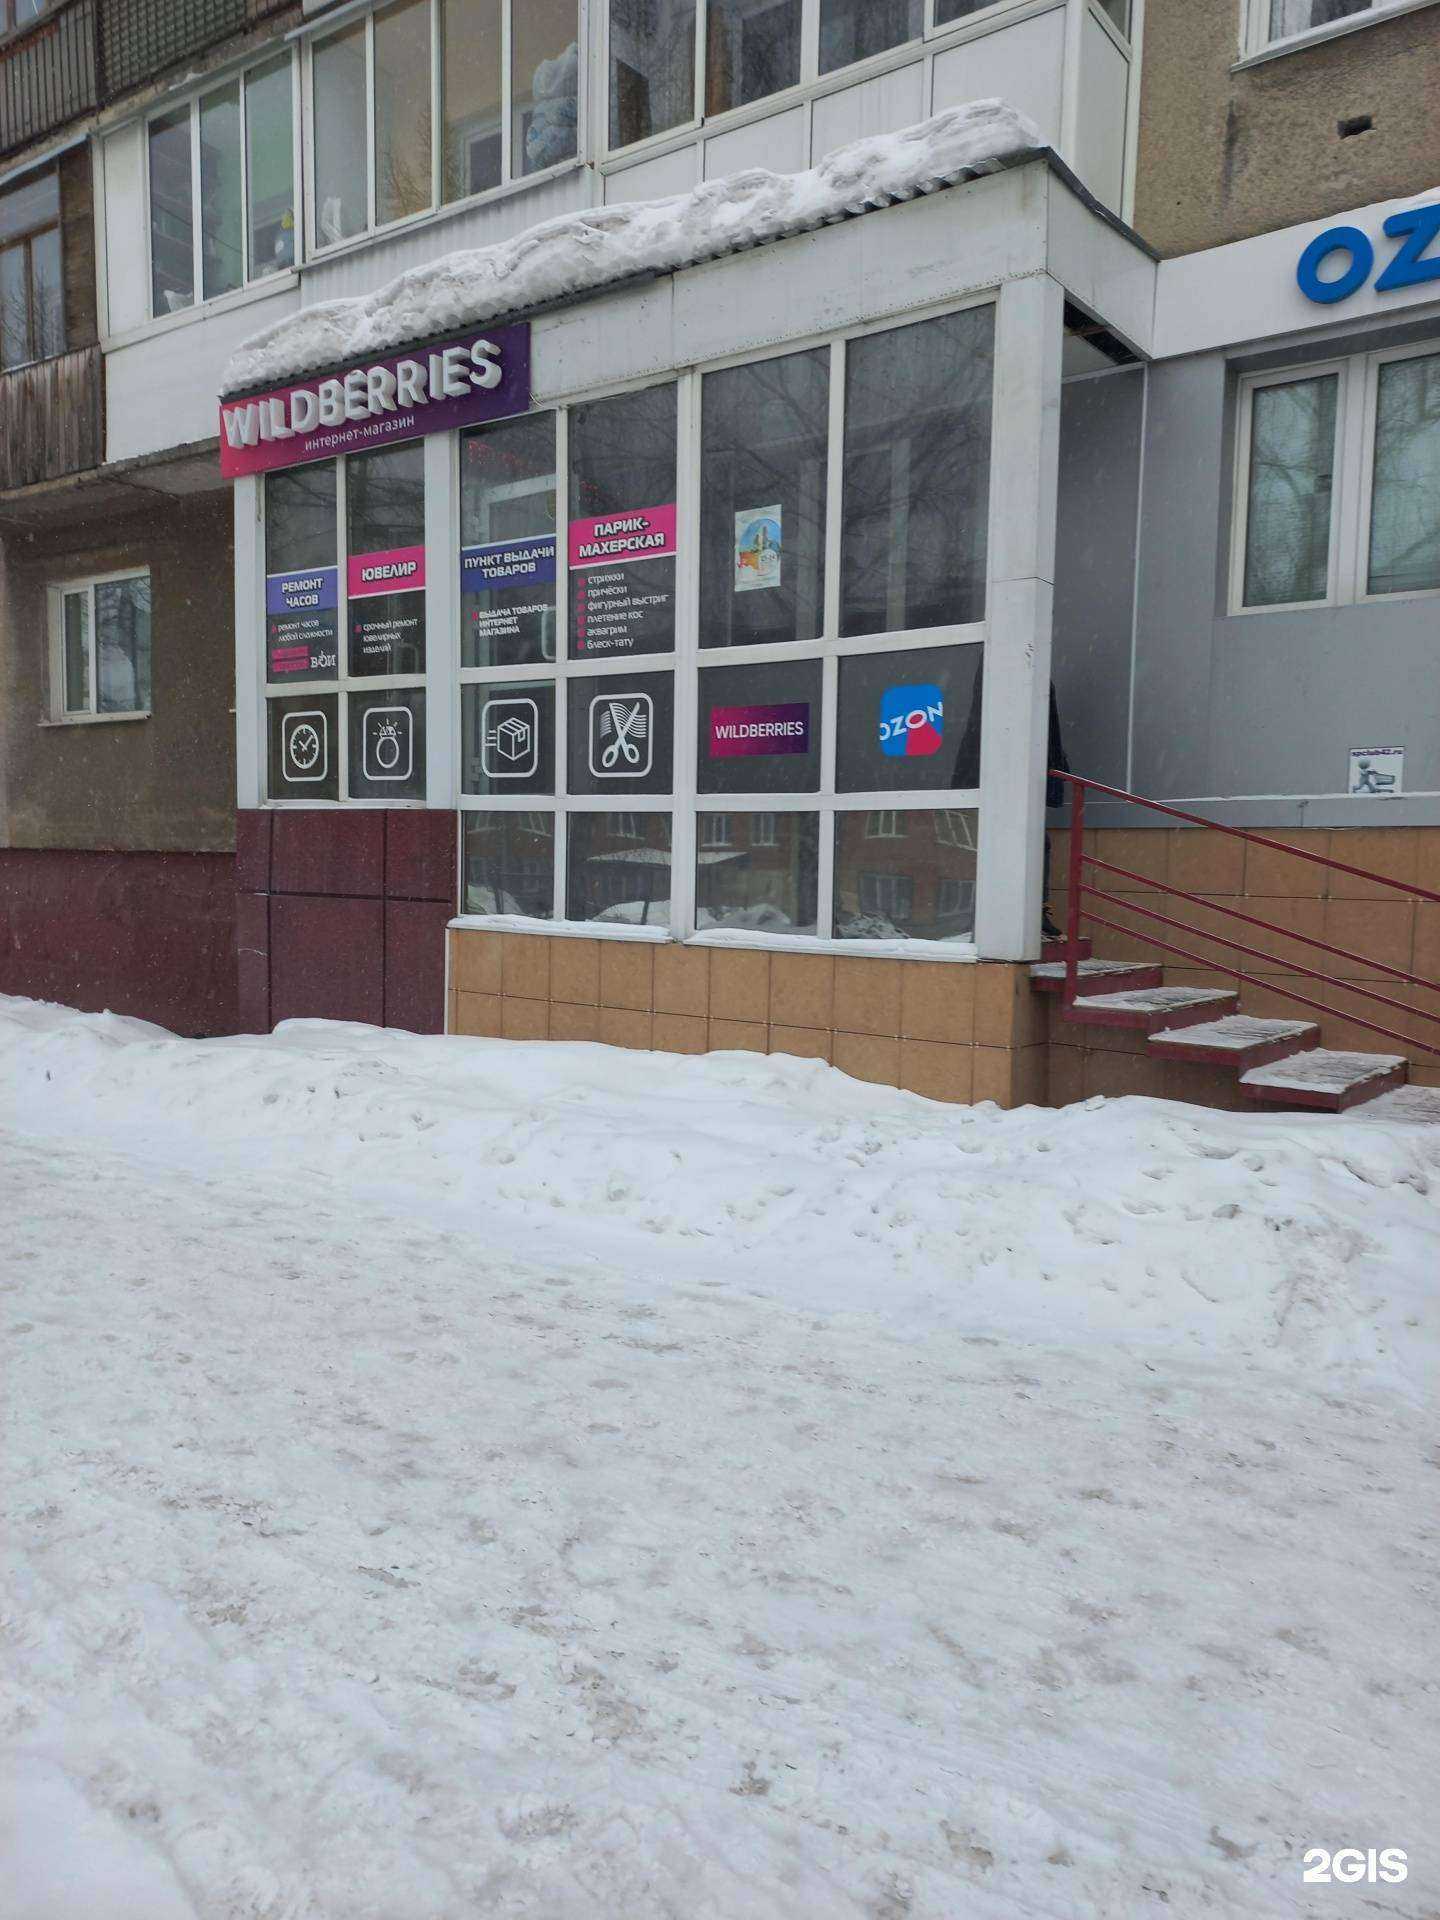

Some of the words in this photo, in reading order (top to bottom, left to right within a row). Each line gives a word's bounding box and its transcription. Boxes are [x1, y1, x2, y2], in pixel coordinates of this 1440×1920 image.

[1296, 203, 1440, 305] OZ
[222, 338, 503, 449] WILDBERRIES
[303, 414, 416, 453] интернет-магазин
[593, 517, 649, 538] ПАРИК-
[578, 532, 665, 559] МАХЕРСКАЯ
[464, 553, 502, 569] ПУНКТ
[503, 545, 555, 563] ВЫДАЧИ
[361, 561, 417, 582] ЮВЕЛИР
[482, 562, 536, 579] ТОВАРОВ
[281, 577, 323, 593] РЕМОНТ
[286, 594, 319, 608] ЧАСОВ
[479, 608, 511, 619] ВЫДАЧА
[512, 604, 548, 616] ТОВАРОВ
[479, 616, 518, 628] ИНТЕРНЕТ
[479, 625, 520, 637] МАГАЗИНА
[715, 720, 804, 740] WILDBERRIES
[879, 701, 943, 741] OZON
